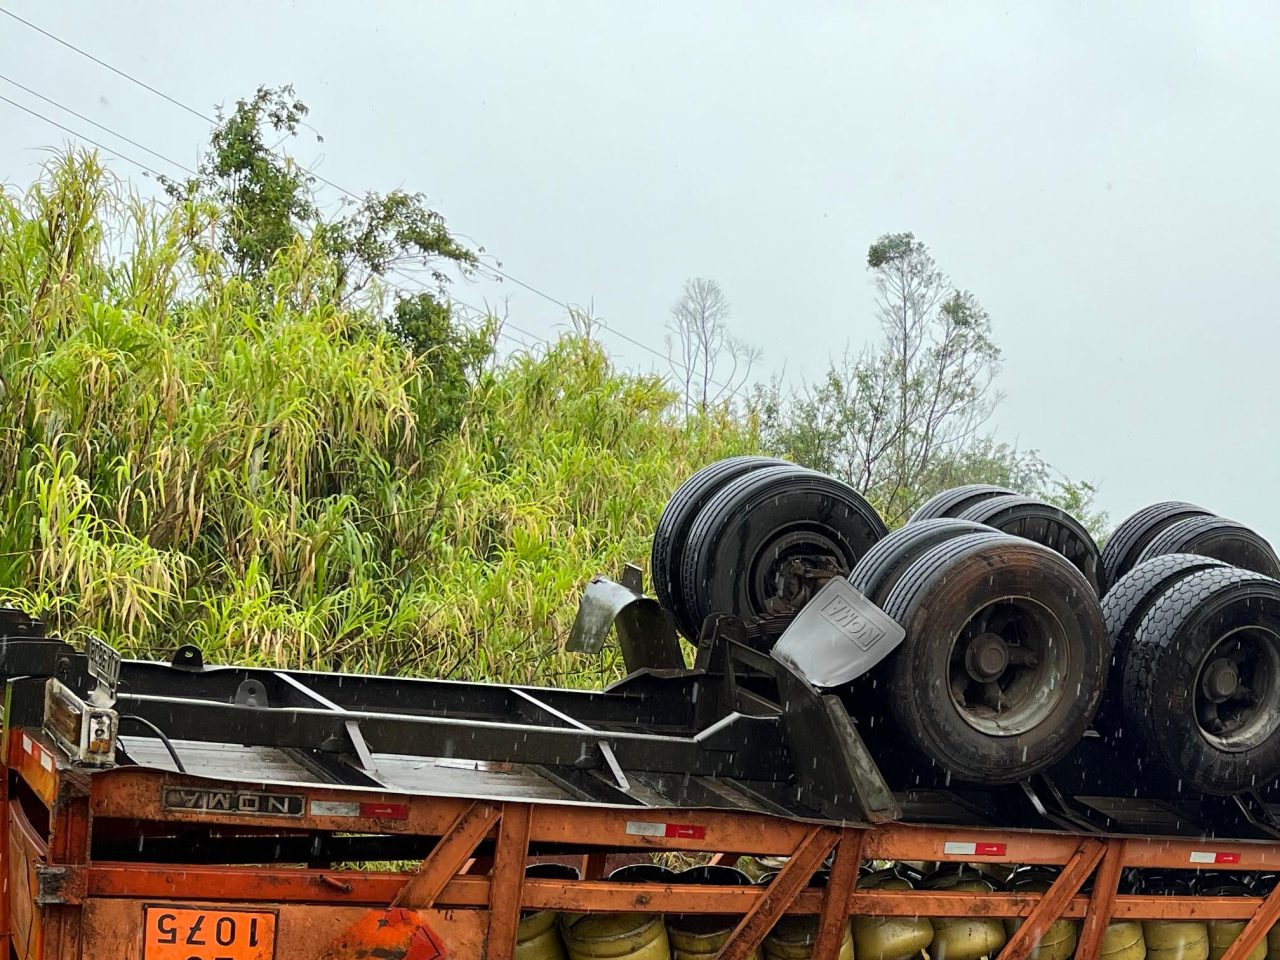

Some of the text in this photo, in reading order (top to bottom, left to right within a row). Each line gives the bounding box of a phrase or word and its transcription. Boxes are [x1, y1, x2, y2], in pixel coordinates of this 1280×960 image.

[827, 600, 880, 647] NOMA
[179, 791, 290, 813] NOMA
[157, 913, 259, 948] 1075
